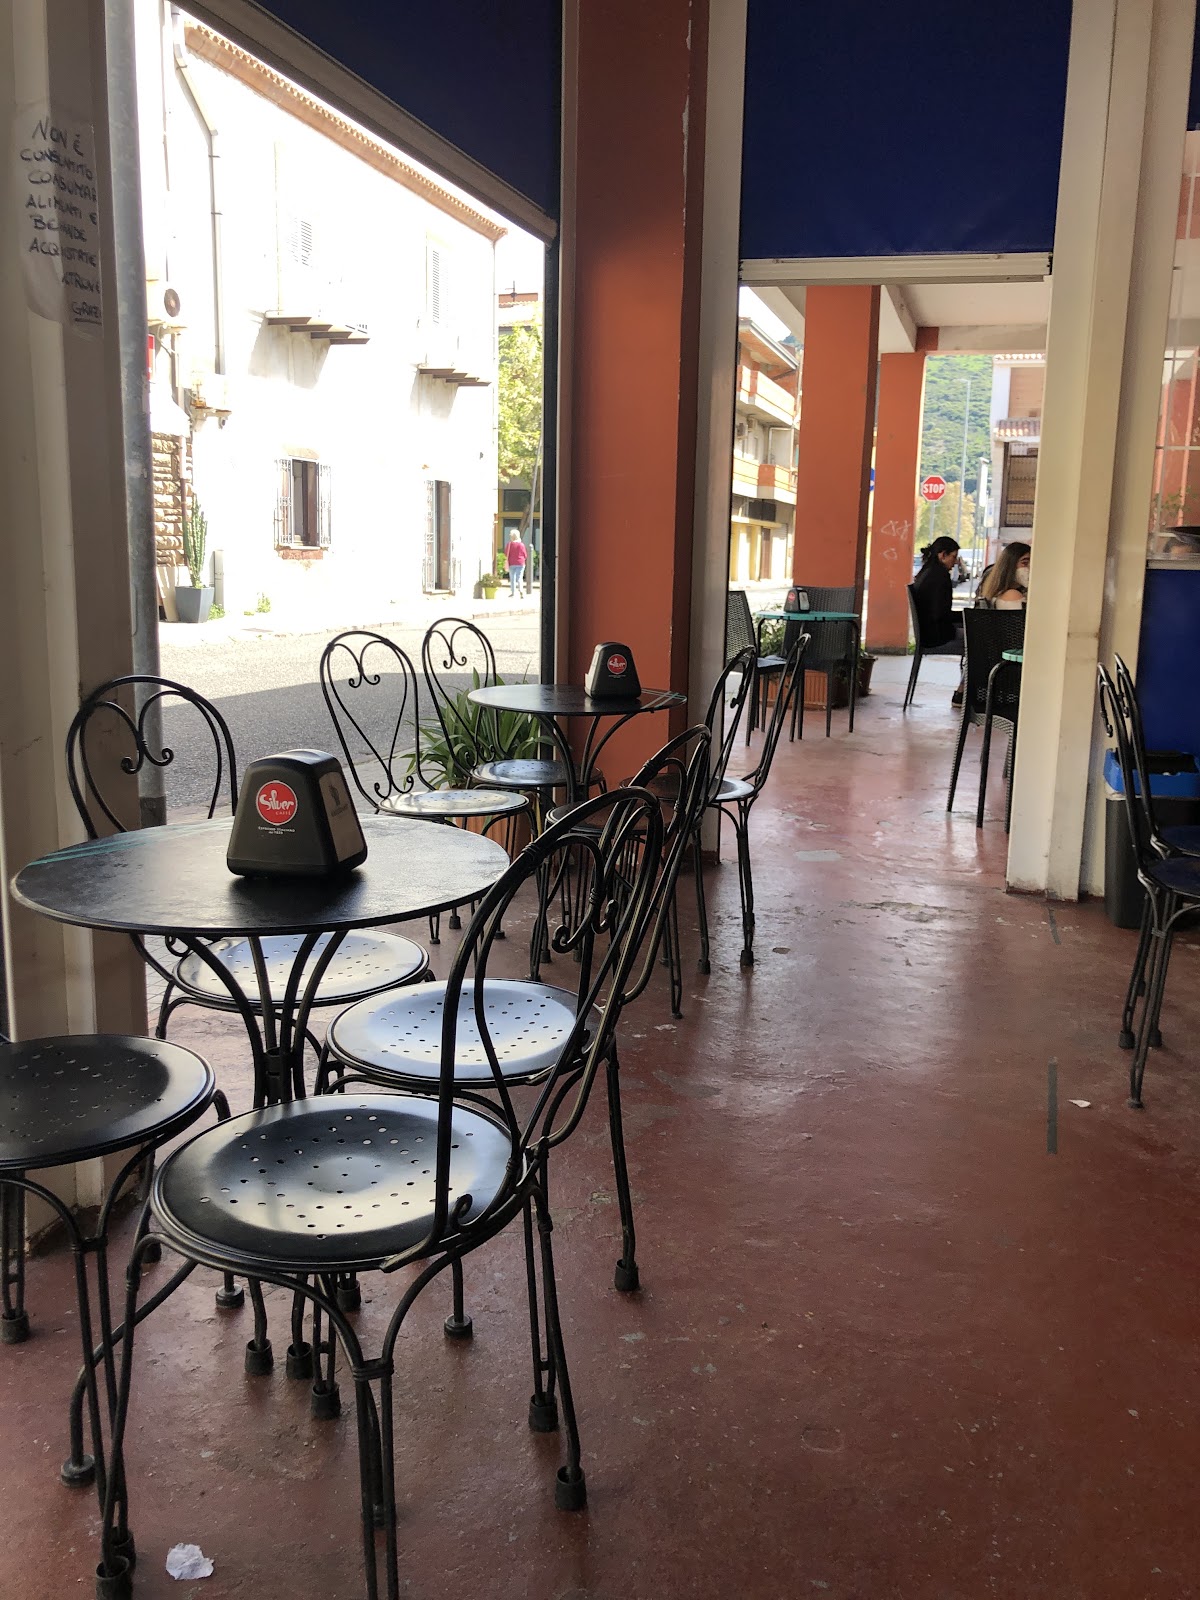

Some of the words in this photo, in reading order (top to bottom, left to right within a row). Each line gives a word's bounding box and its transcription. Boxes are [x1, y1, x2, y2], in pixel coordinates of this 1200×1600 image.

[31, 116, 68, 149] NON
[922, 483, 945, 494] STOP
[259, 789, 294, 811] Silver
